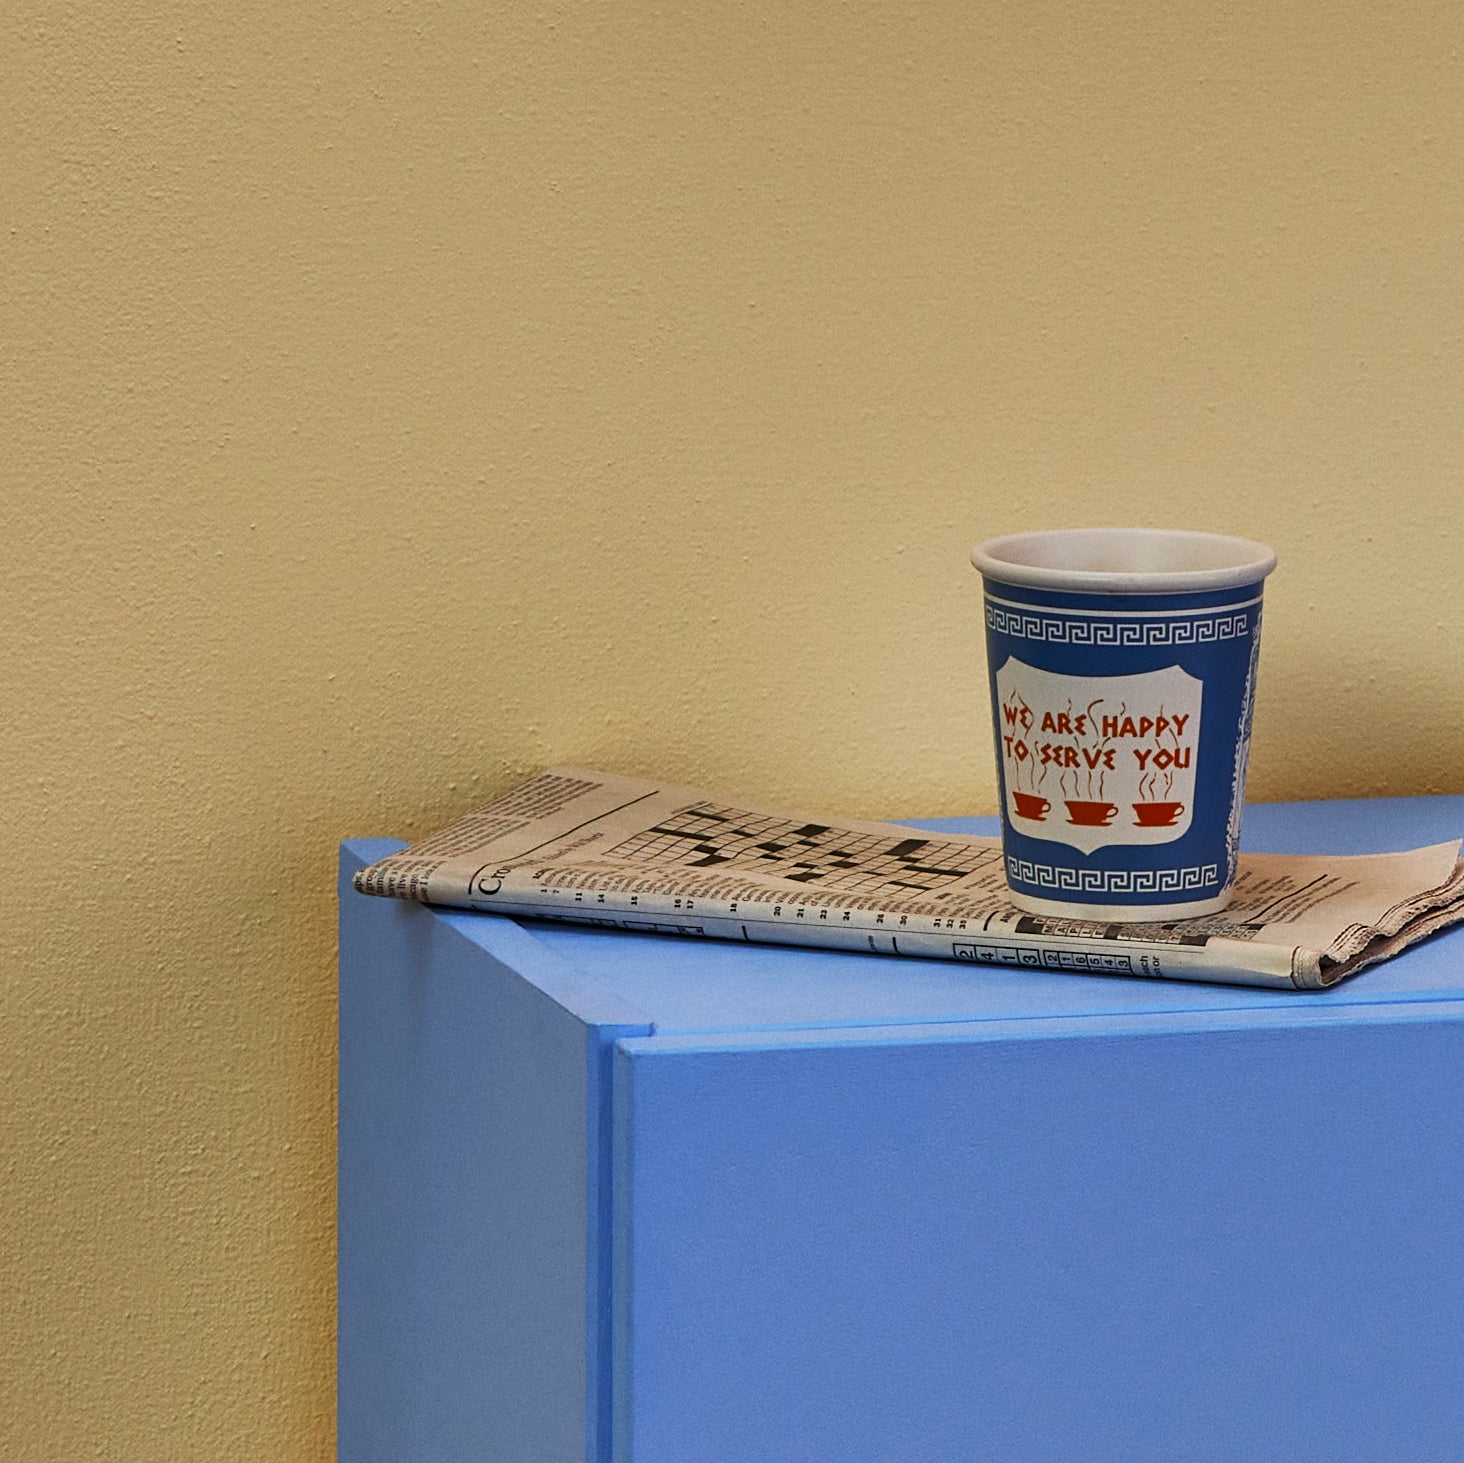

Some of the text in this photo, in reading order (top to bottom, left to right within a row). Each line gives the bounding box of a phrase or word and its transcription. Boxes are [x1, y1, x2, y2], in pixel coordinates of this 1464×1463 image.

[1003, 703, 1190, 739] WE ARE HAPPY
[1004, 736, 1192, 770] TO SERVE YOU
